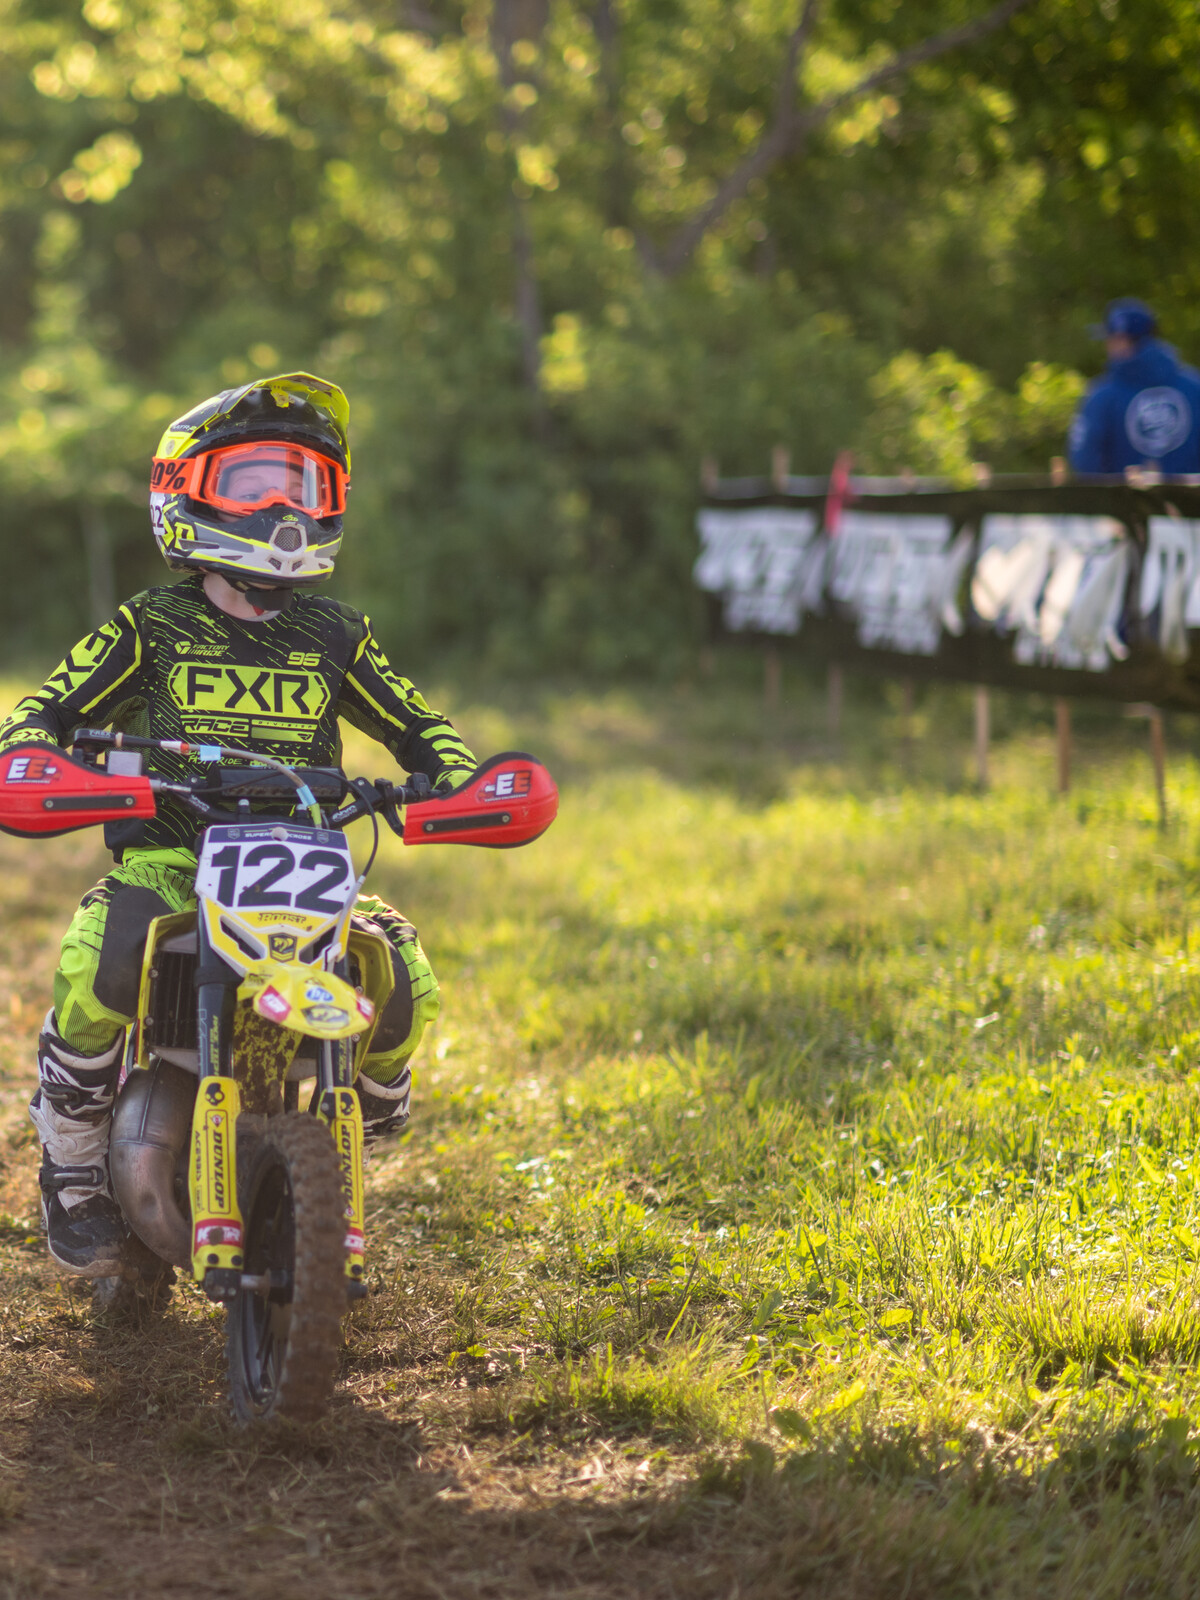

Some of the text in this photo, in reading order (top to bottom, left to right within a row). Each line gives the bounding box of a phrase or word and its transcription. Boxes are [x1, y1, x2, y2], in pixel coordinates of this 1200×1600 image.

[187, 665, 311, 715] FXR
[182, 718, 250, 735] RACE
[211, 844, 350, 915] 122
[212, 1129, 225, 1209] DUNLOP
[340, 1124, 353, 1203] DUNLOP
